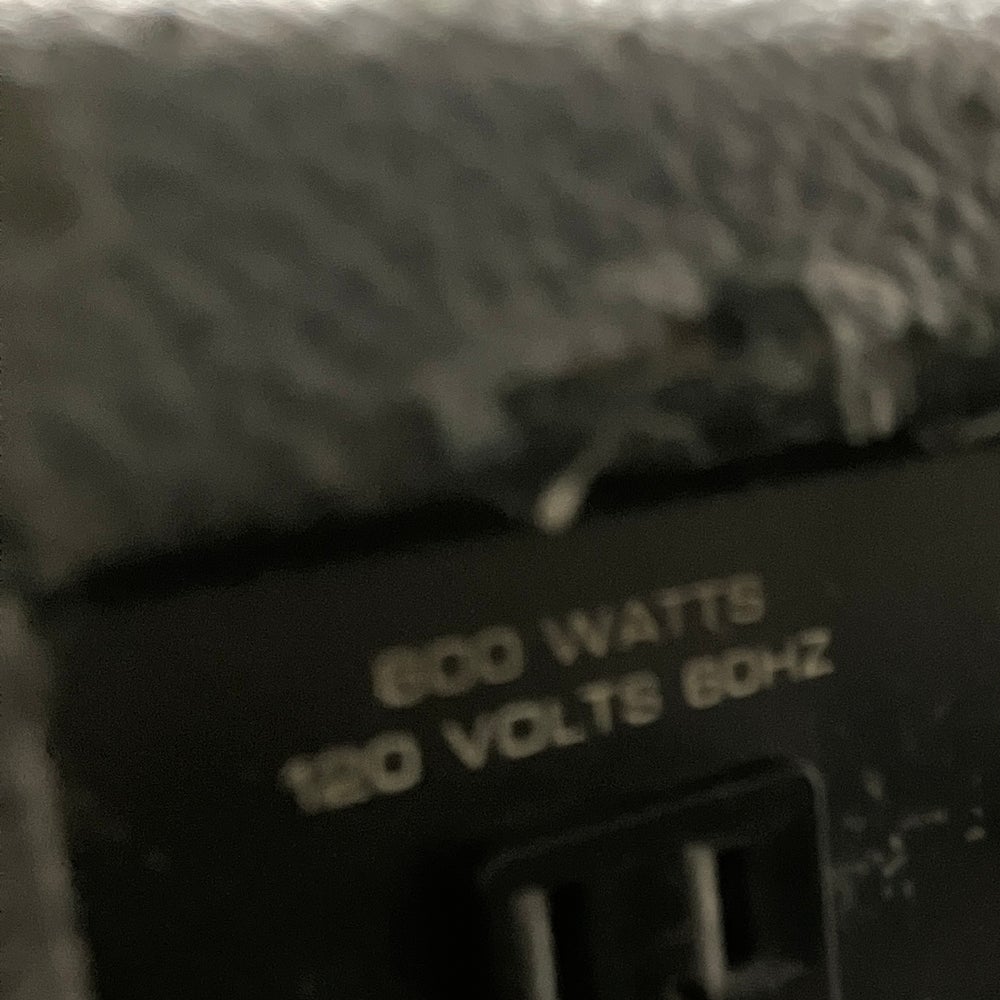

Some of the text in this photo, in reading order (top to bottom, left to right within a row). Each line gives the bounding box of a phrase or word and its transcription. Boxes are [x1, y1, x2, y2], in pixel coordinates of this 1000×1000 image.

[371, 573, 766, 708] 600 WATTS
[441, 670, 663, 770] VOLTS
